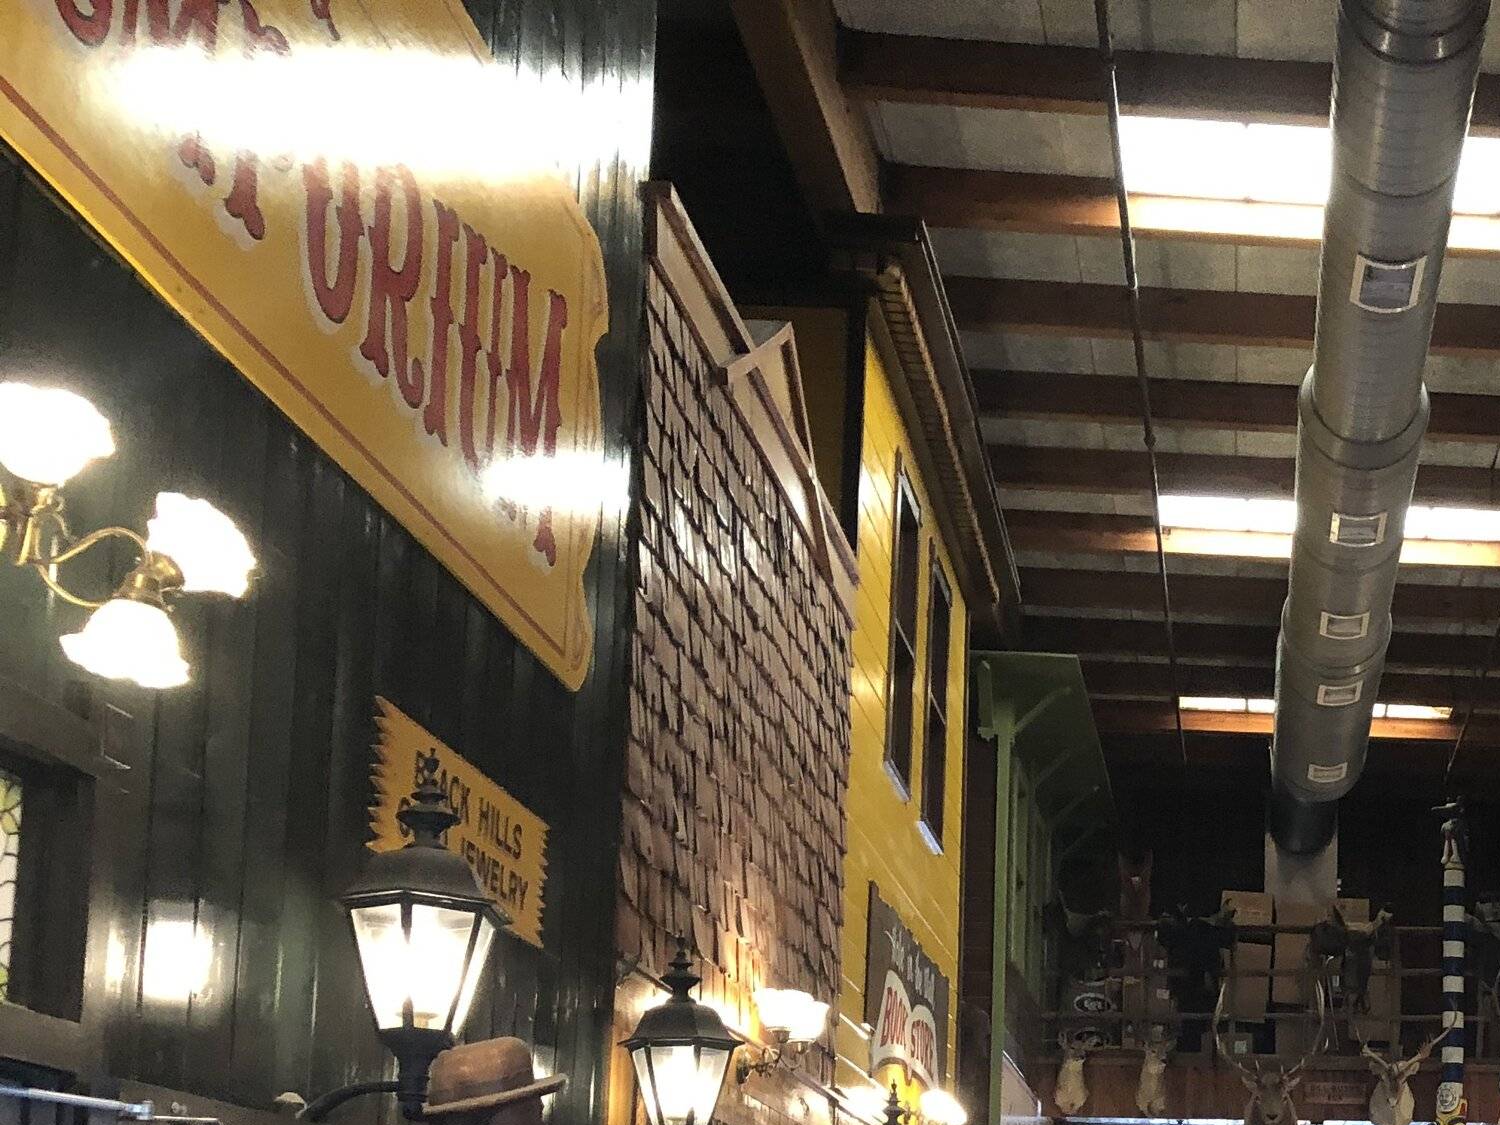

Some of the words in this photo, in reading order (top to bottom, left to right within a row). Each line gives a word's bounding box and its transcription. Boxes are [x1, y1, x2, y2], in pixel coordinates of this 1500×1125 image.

[414, 749, 470, 825] BACK
[477, 797, 523, 860] HILLS
[911, 1018, 935, 1083] STORE
